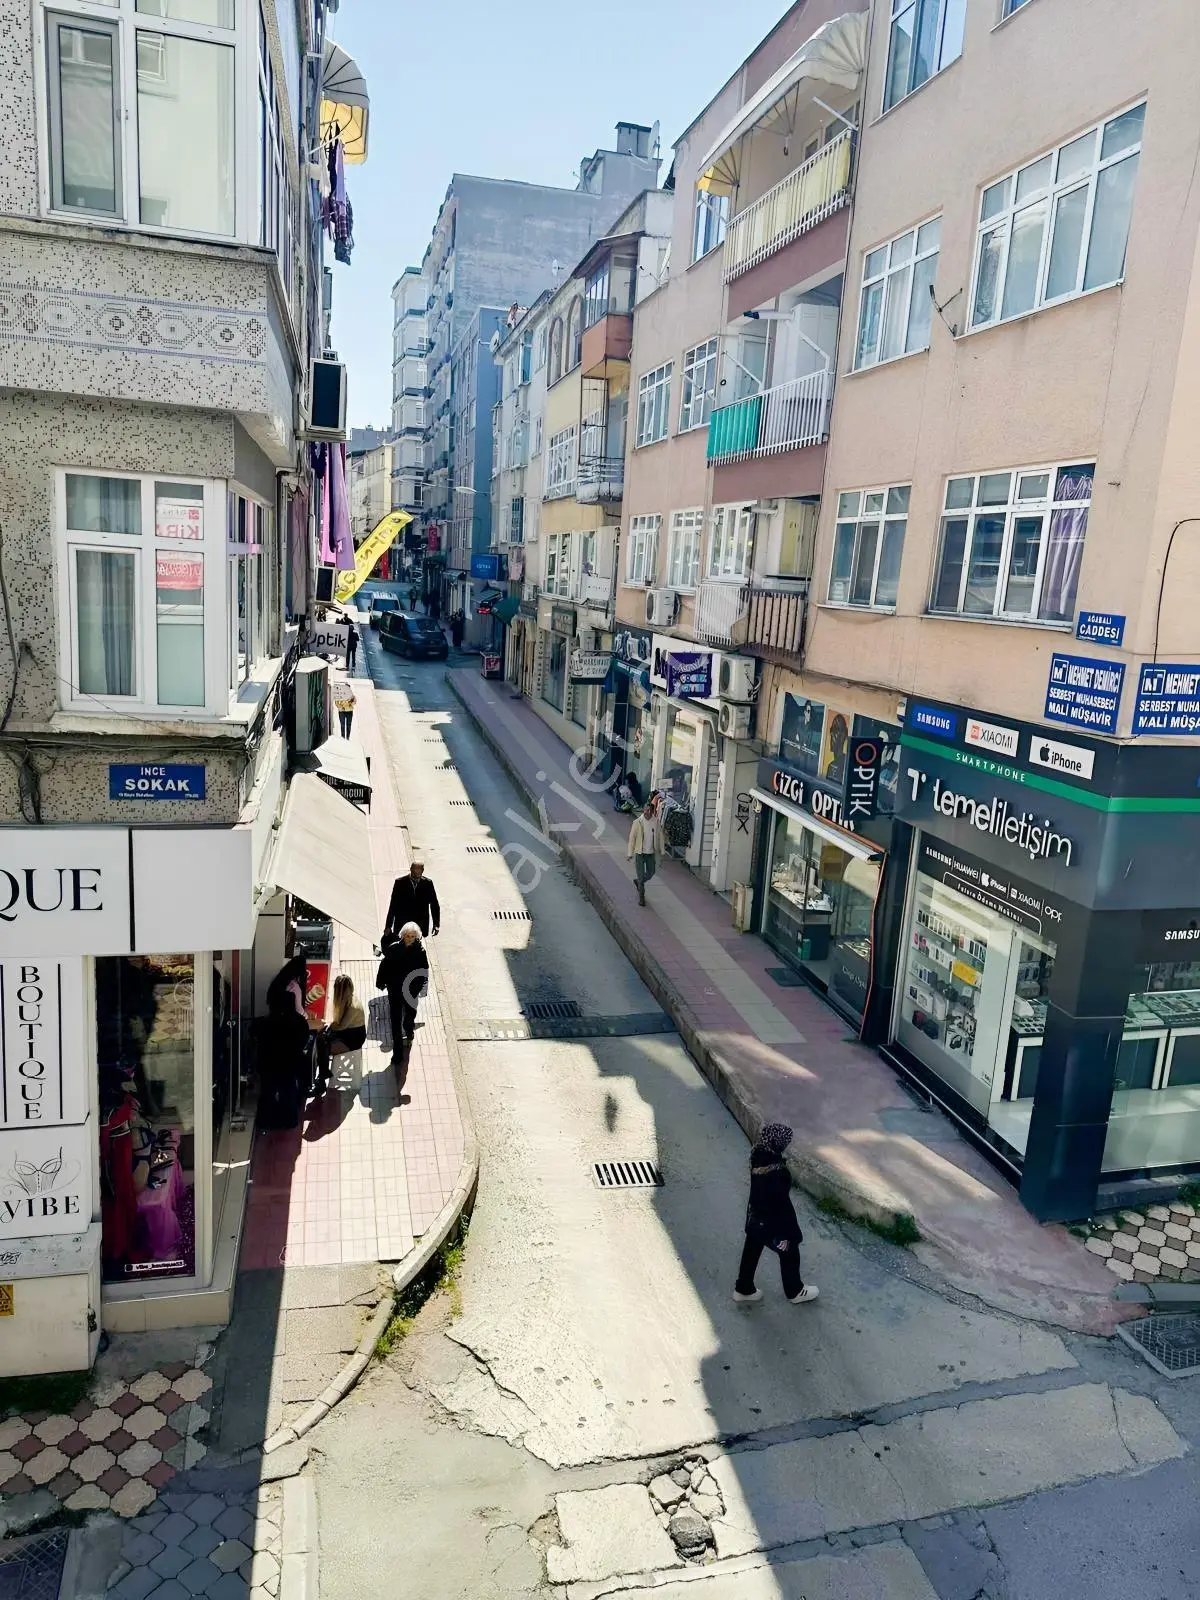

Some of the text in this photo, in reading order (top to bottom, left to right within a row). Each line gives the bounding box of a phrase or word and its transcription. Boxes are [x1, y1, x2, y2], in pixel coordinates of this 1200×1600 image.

[1067, 664, 1094, 688] MEHMET
[1048, 687, 1076, 702] SERBEST
[1048, 702, 1112, 727] MALİ MÜŞAVİR
[1139, 700, 1176, 712] SERBEST
[916, 711, 951, 730] SAMSUNG
[1138, 713, 1168, 728] MALİ
[980, 727, 1013, 750] XIAOMI
[140, 766, 166, 776] INCE
[955, 753, 1026, 783] SMARTPHONE
[1050, 751, 1083, 772] iPhone
[125, 778, 190, 792] SOKAK
[925, 846, 952, 866] SAMSUNG
[953, 860, 979, 880] HUAWEI
[1018, 892, 1041, 911] XIAOMI
[16, 965, 47, 1120] BOUTIQUE
[0, 1195, 81, 1224] VIBE
